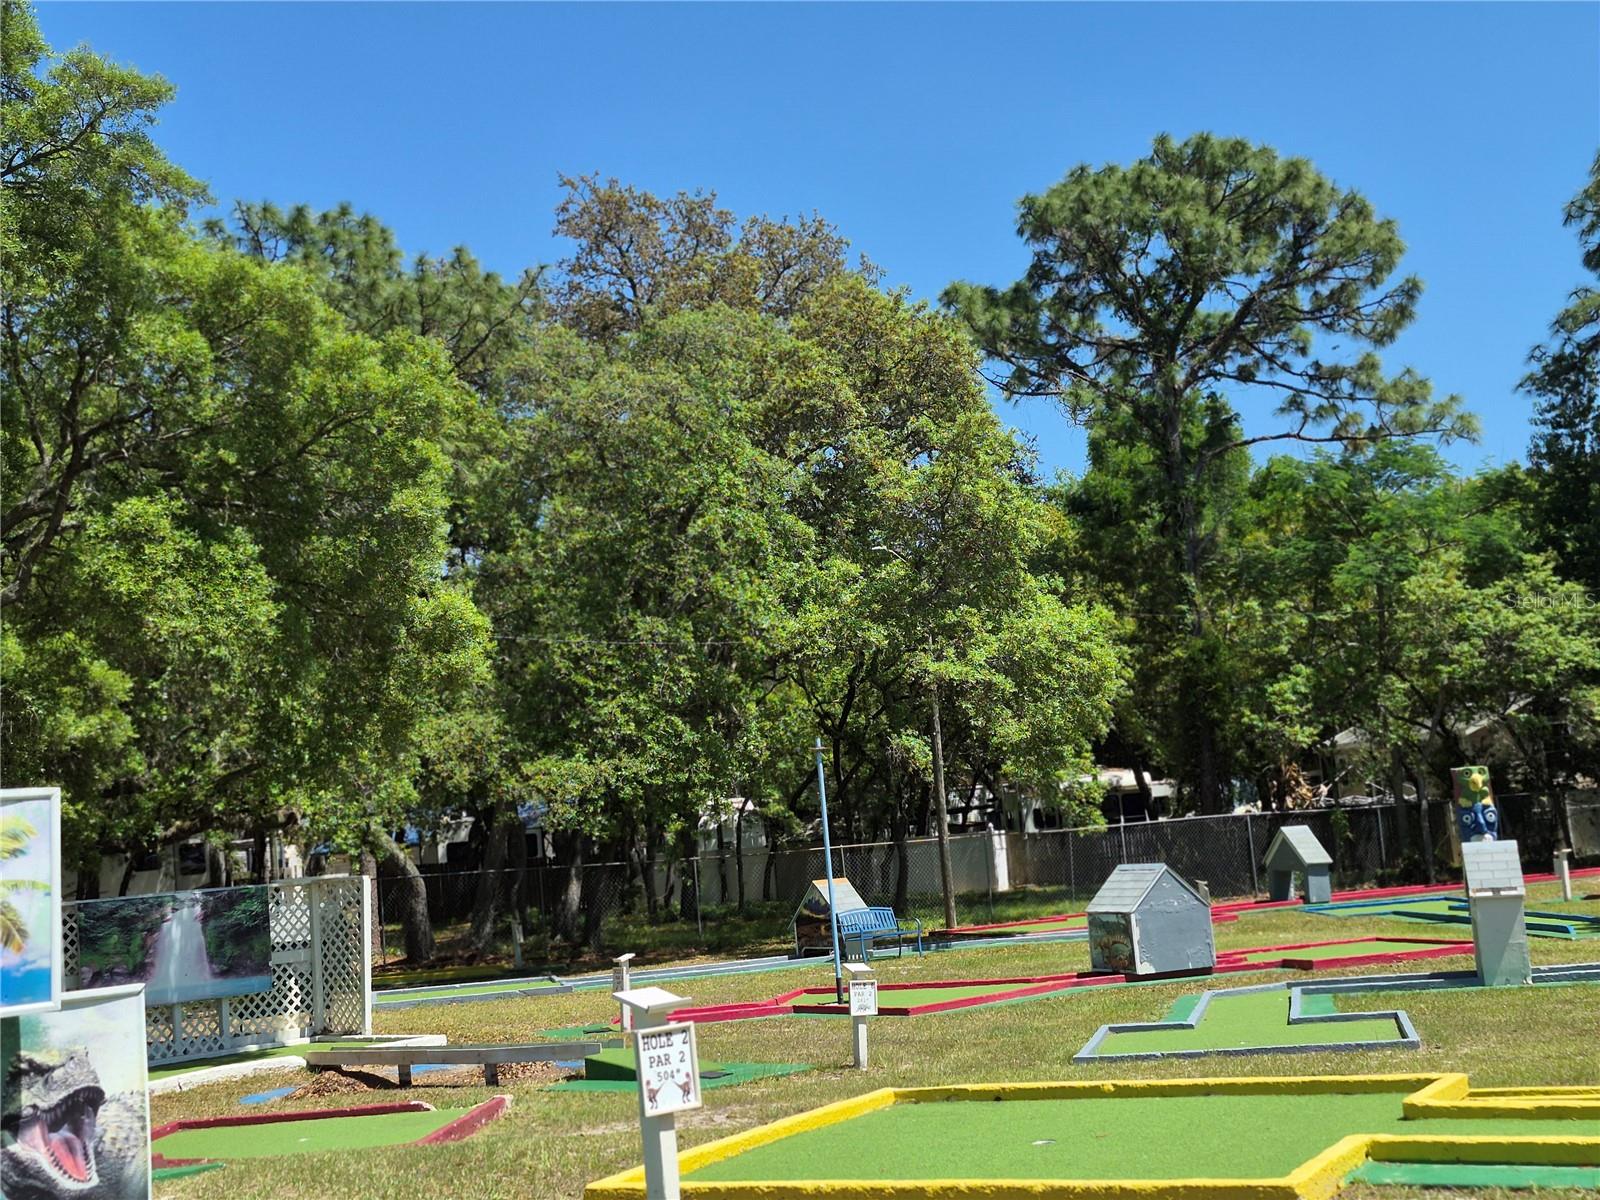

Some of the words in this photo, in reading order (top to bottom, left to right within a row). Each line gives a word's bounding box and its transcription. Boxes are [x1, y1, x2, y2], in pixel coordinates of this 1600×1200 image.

[641, 1032, 674, 1052] HOLE
[681, 1029, 689, 1045] 2
[648, 1053, 672, 1069] PAR
[678, 1050, 686, 1063] 2
